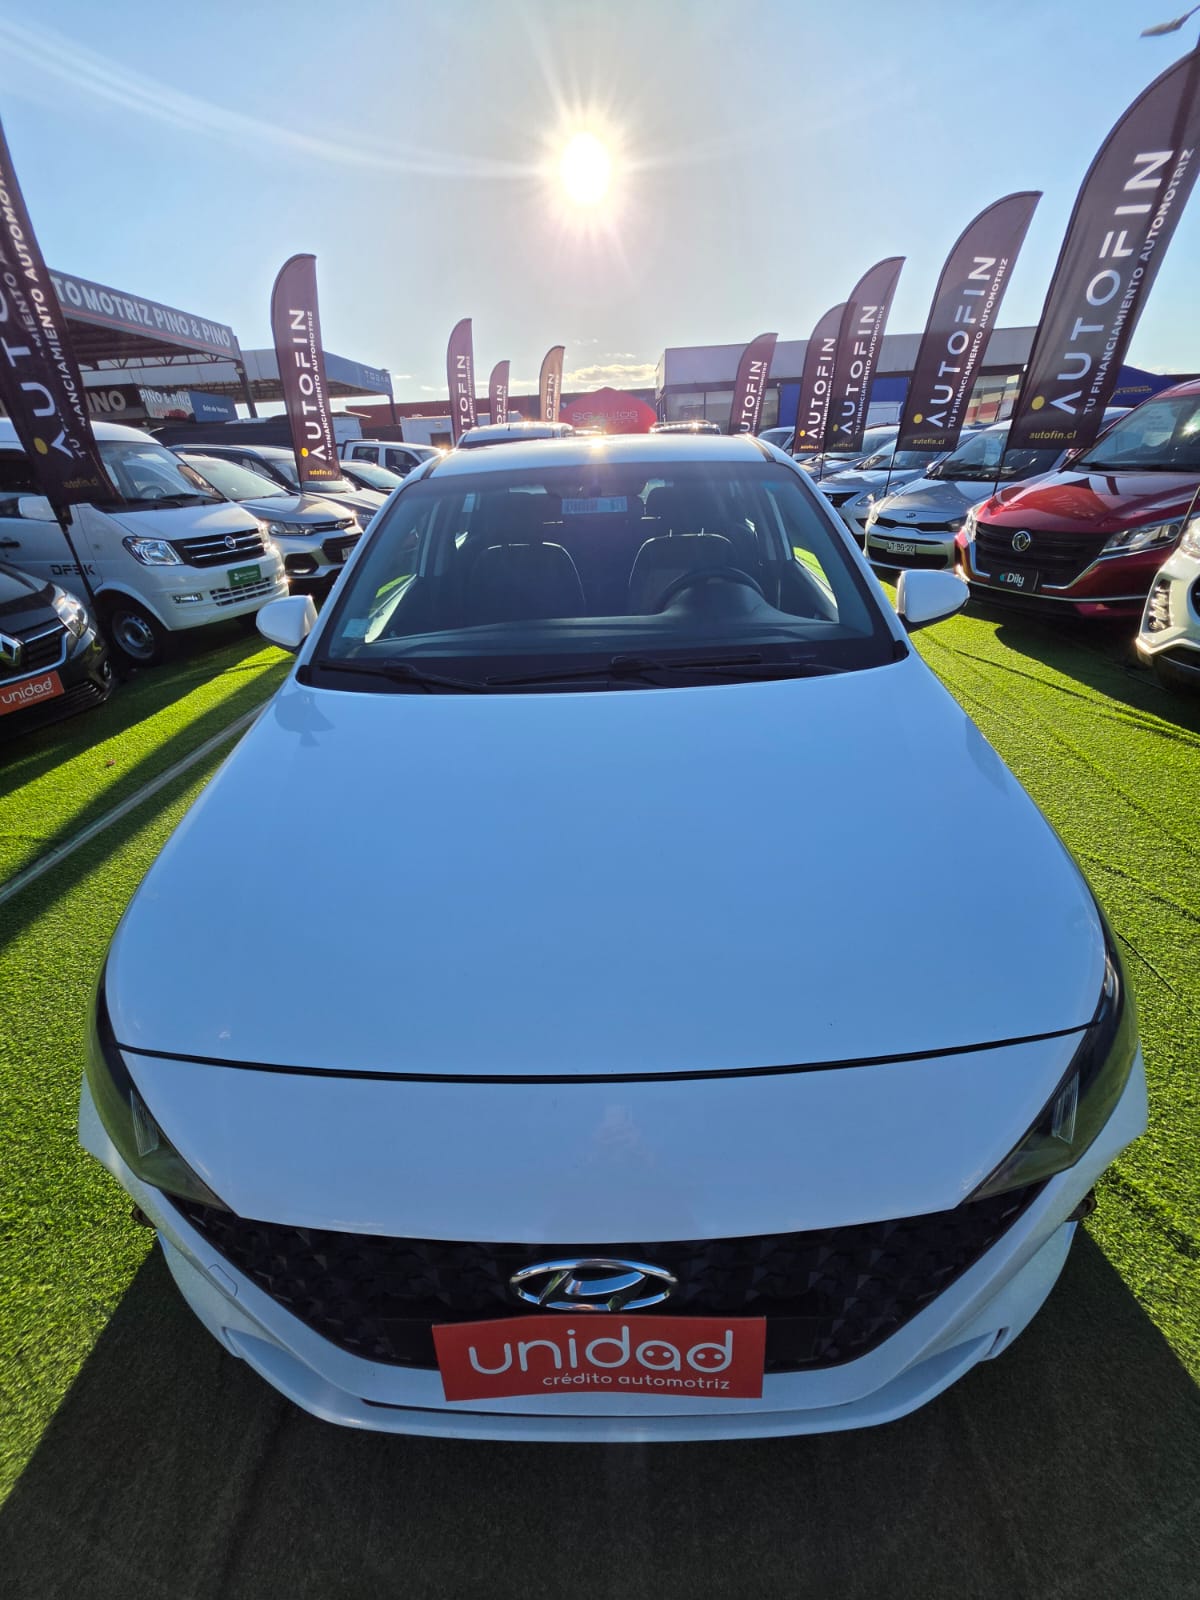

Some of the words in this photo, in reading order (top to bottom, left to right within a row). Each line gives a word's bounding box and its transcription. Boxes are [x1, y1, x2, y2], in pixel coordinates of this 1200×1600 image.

[980, 258, 1008, 328] AUTOMOTRIZ
[1050, 150, 1173, 415] AUTOFIN
[1083, 398, 1096, 415] TU
[1090, 267, 1143, 394] FINANCIAMIENTO
[1139, 148, 1195, 261] AUTOMOTRIZ
[152, 306, 189, 335] PINO
[190, 319, 202, 339] &
[201, 323, 232, 347] PINO
[307, 311, 319, 372] AUTOMOTRIZ
[926, 256, 996, 428] AUTOFIN
[289, 309, 327, 460] AUTOFIN
[457, 355, 470, 433] TOFIN
[807, 338, 836, 438] AUTOFIN
[840, 305, 878, 435] AUTOFIN
[951, 331, 983, 415] FINANCIAMIENTO
[314, 374, 333, 448] FINANCIAMIENTO
[948, 416, 957, 428] TU
[1029, 430, 1077, 440] autofin.cl
[1007, 573, 1024, 587] Dily
[1, 677, 52, 704] unidad
[468, 1326, 733, 1375] unidad
[542, 1372, 612, 1386] crédito
[618, 1374, 730, 1390] automotriz
